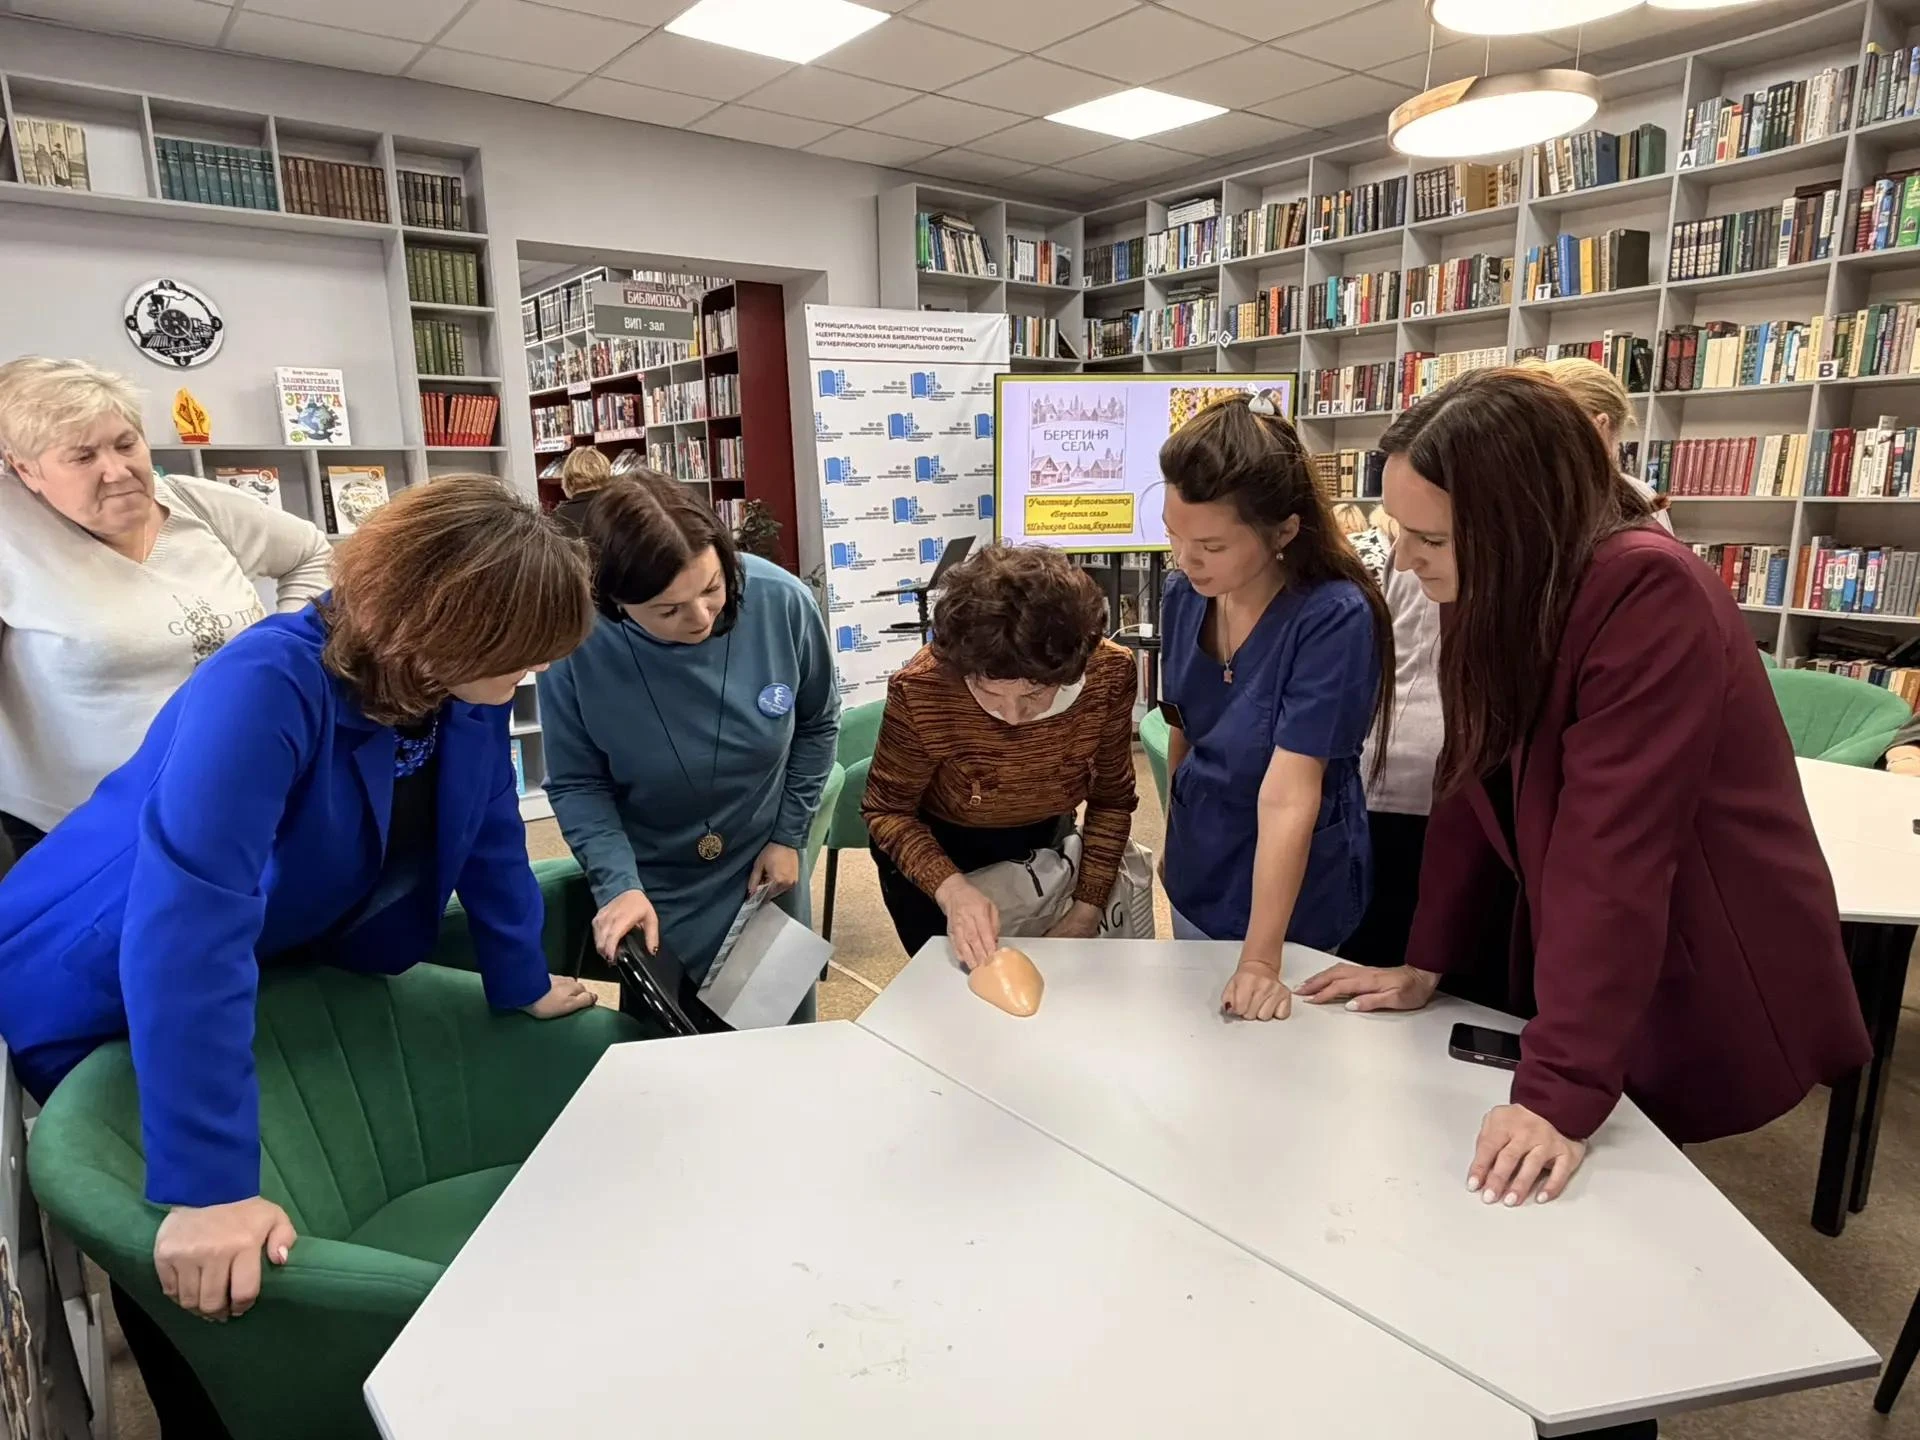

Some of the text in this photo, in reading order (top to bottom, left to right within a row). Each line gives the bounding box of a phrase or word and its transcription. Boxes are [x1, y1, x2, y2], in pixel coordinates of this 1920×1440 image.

[1680, 153, 1692, 168] А
[1454, 200, 1464, 214] Н
[1222, 249, 1229, 258] А
[1189, 256, 1196, 265] Б
[989, 265, 995, 275] Б
[1539, 286, 1549, 298] Т
[627, 291, 682, 308] БИБЛИОТЕКА
[1413, 304, 1423, 315] О
[624, 317, 642, 330] ВИП
[648, 321, 665, 332] зал
[814, 321, 964, 335] МУНИЦИПАЛЬНОЕ БЮДЖЕТНОЕ УЧРЕЖДЕНИЕ
[892, 334, 943, 342] БИБЛИОТЕЧНАЯ
[1222, 334, 1230, 344] Б
[816, 340, 876, 349] ШУМЕРЛИНСКОГО
[877, 343, 940, 351] МУНИЦИПАЛЬНОГО
[1015, 345, 1022, 354] Е
[1819, 363, 1834, 378] В
[1320, 404, 1327, 413] Е
[1333, 403, 1342, 411] Ж
[1355, 400, 1363, 409] И
[1043, 428, 1109, 442] БЕРЕГИНЯ
[1061, 441, 1095, 452] СЕЛА
[168, 613, 232, 639] GOOD
